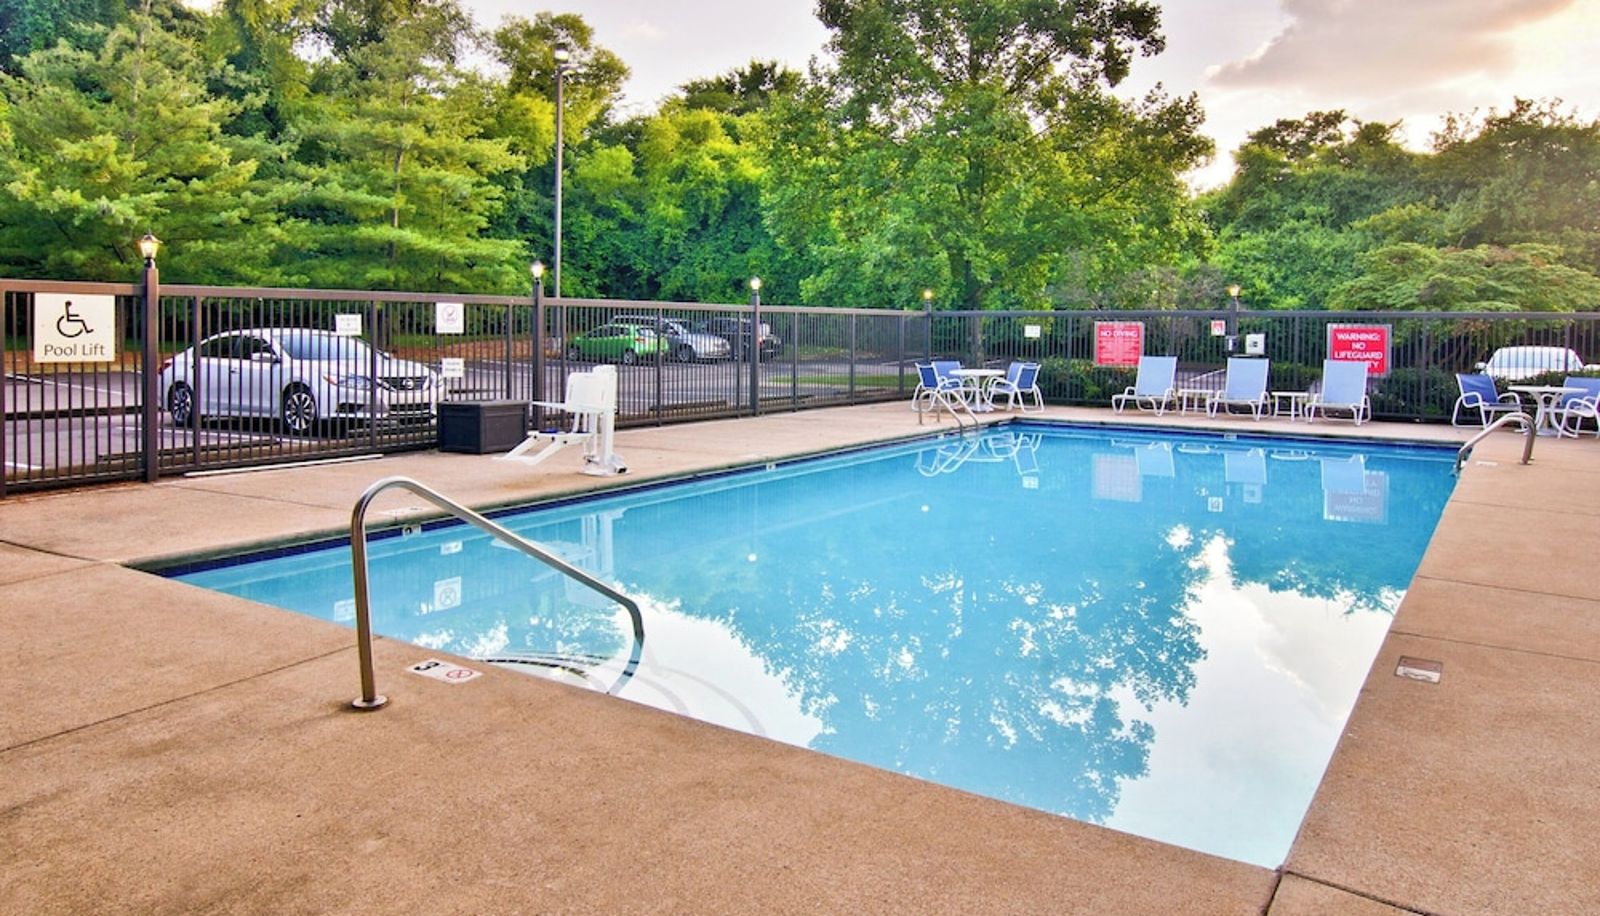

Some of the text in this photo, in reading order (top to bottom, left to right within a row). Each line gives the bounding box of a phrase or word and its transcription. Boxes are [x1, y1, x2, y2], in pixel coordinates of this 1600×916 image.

[1336, 332, 1381, 340] WARNING:
[44, 343, 105, 357] Pool Lift
[1351, 342, 1366, 350] NO
[1333, 350, 1383, 360] LIFEGUARD
